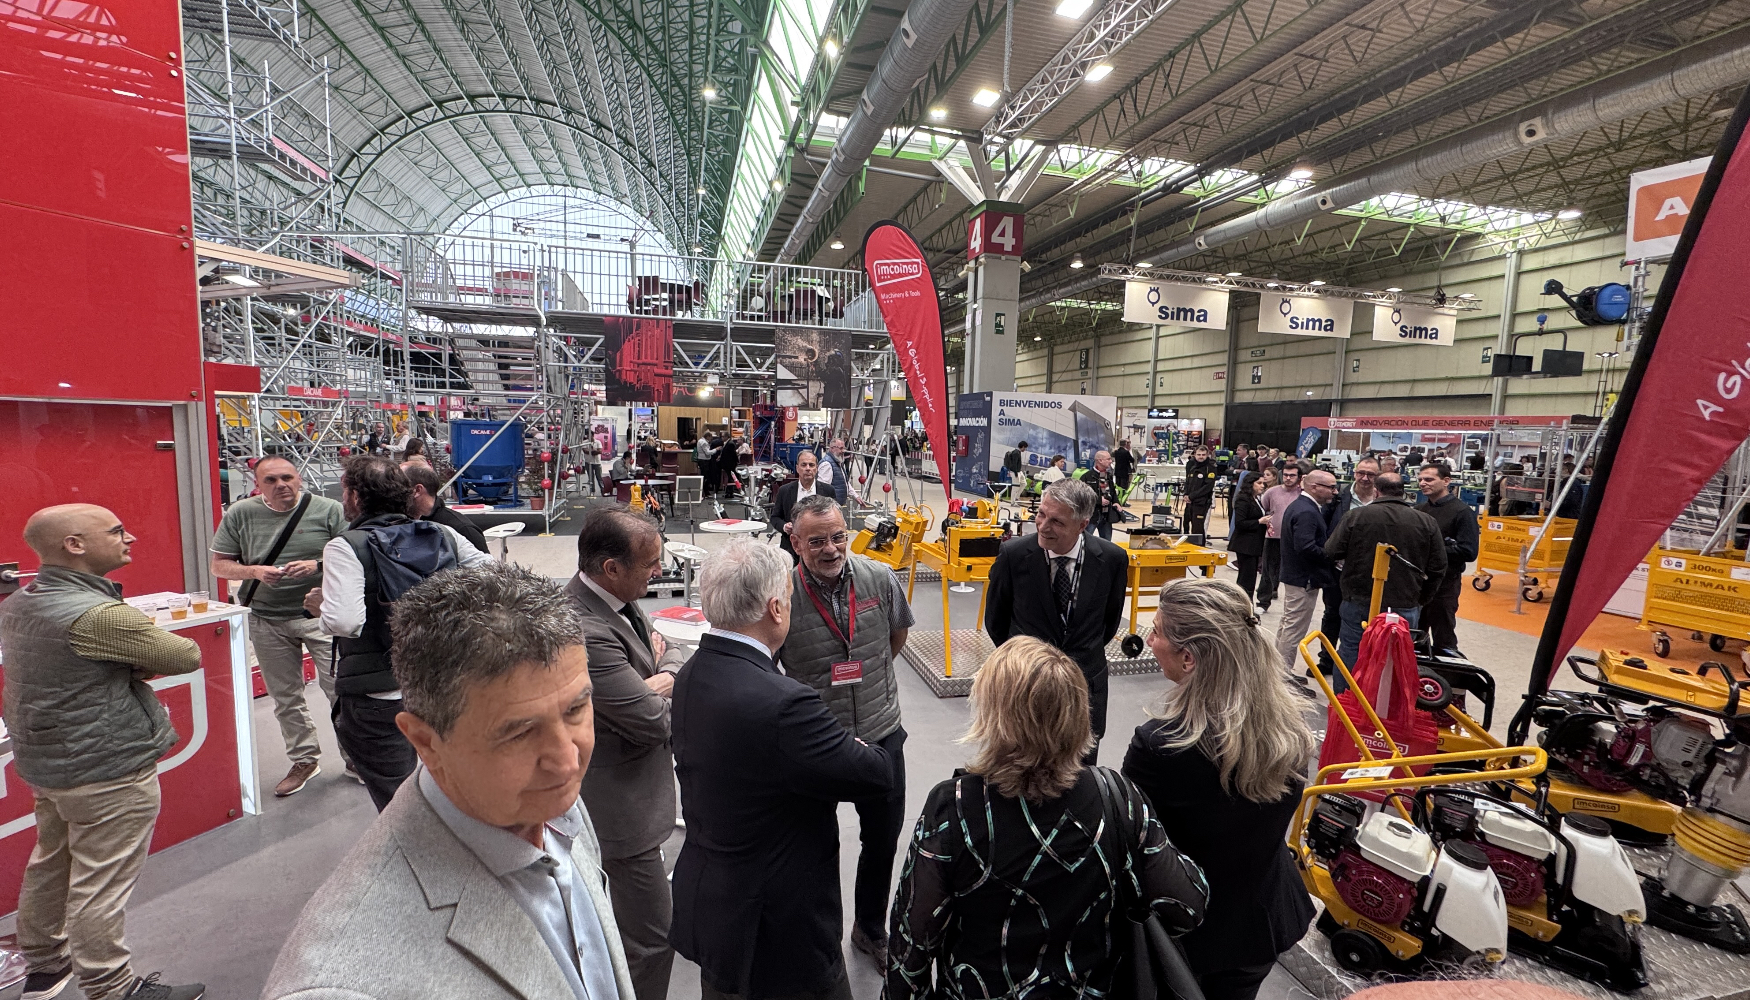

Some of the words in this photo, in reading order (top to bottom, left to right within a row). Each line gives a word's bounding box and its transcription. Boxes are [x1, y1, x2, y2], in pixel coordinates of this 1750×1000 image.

[970, 217, 982, 254] 4
[991, 216, 1016, 252] 4
[877, 263, 919, 276] imcoinsa
[881, 291, 905, 300] Machinery
[909, 289, 921, 297] Tools
[1157, 305, 1208, 323] sima
[1288, 315, 1335, 333] sima
[1398, 324, 1440, 341] sima
[906, 340, 913, 349] A
[908, 348, 925, 378] Global
[303, 387, 323, 396] DACAME
[919, 376, 936, 413] Supplier
[999, 398, 1063, 410] BIENVENIDOS
[1696, 399, 1725, 421] A
[998, 408, 1006, 417] A
[959, 415, 988, 427] INNOVACIÓN
[998, 418, 1022, 427] SIMA
[1410, 419, 1429, 427] QUE
[1431, 419, 1471, 427] GENERA
[1690, 563, 1725, 575] 300KG
[1673, 577, 1740, 594] ALIMAK
[1576, 800, 1617, 811] imcoinsa
